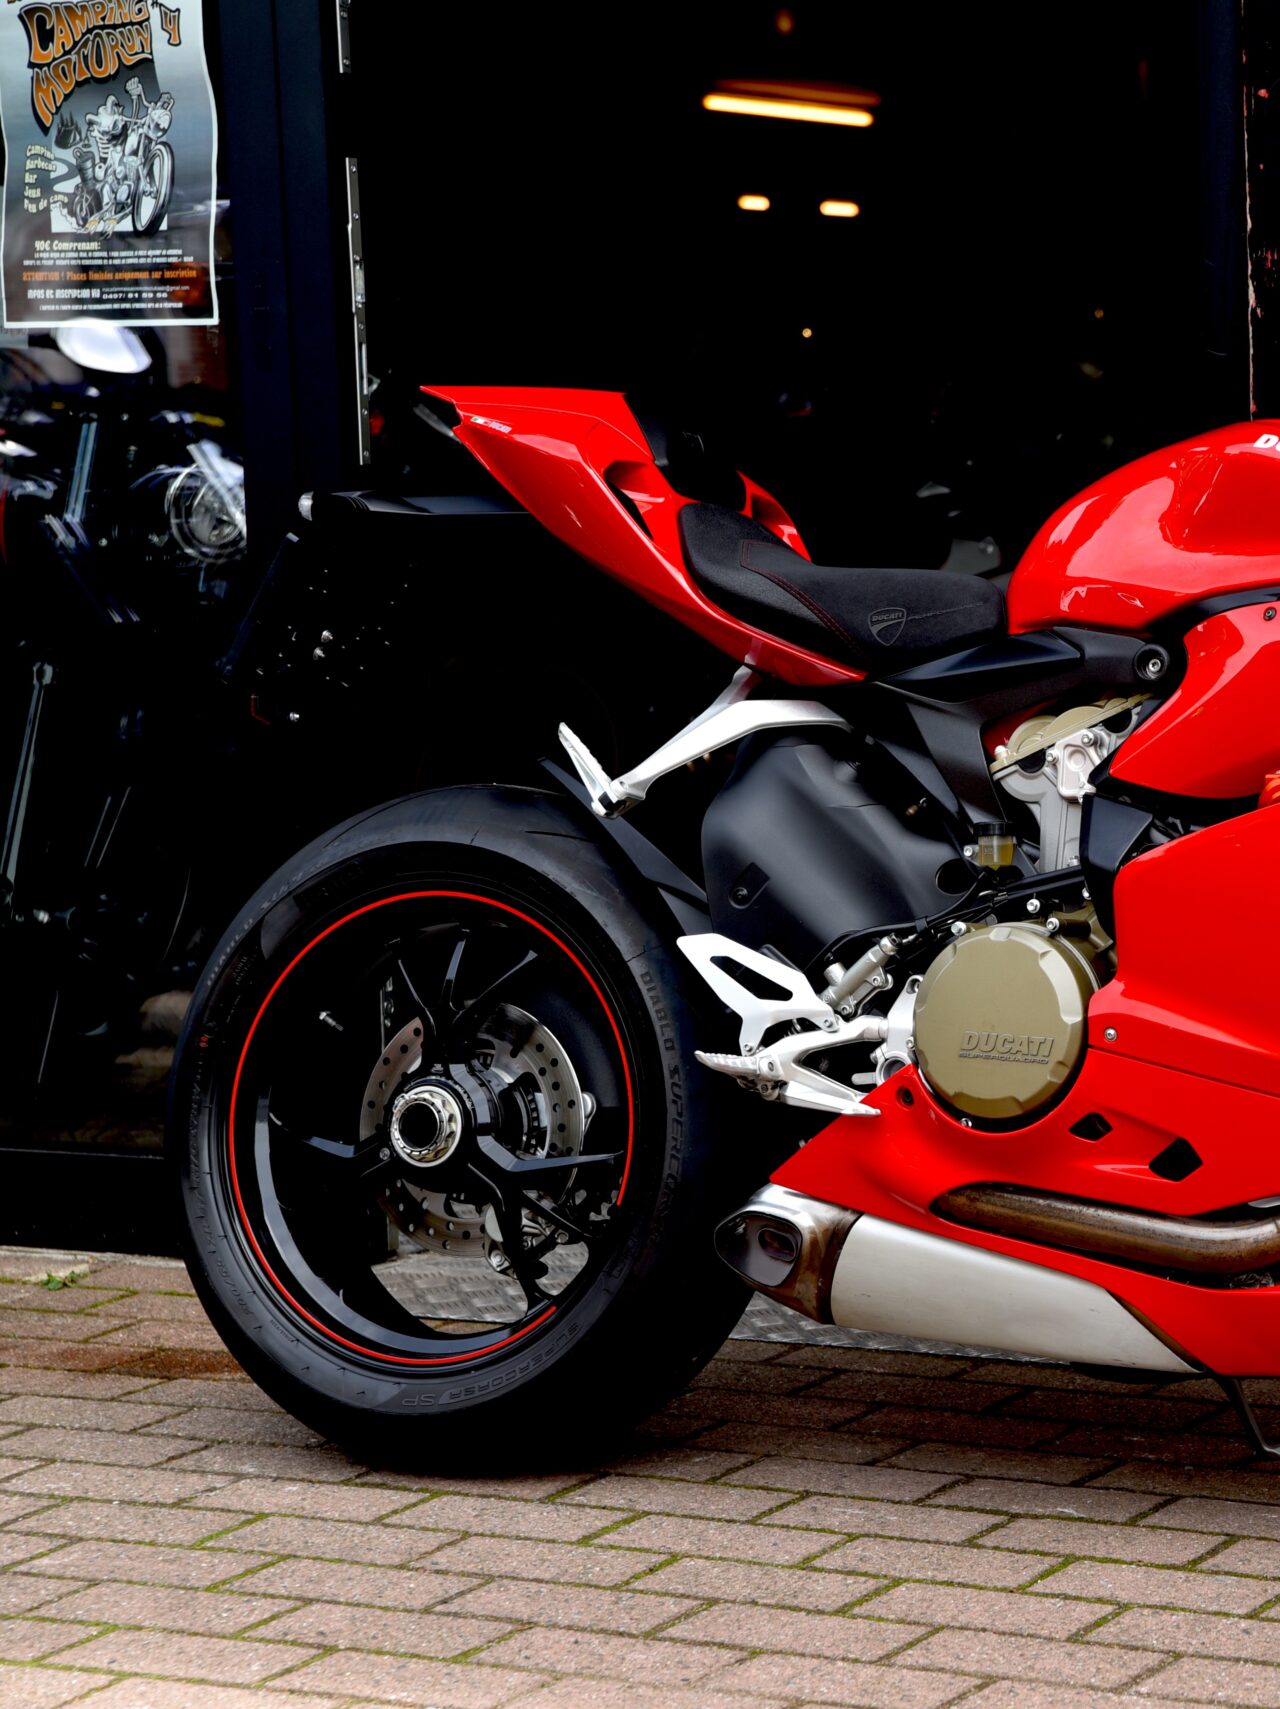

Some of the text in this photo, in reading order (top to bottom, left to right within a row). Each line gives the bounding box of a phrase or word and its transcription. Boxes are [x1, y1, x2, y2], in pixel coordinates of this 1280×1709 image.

[19, 0, 151, 65] CAMPING
[33, 21, 153, 128] MOTORUN
[960, 1030, 1054, 1057] DUCATI
